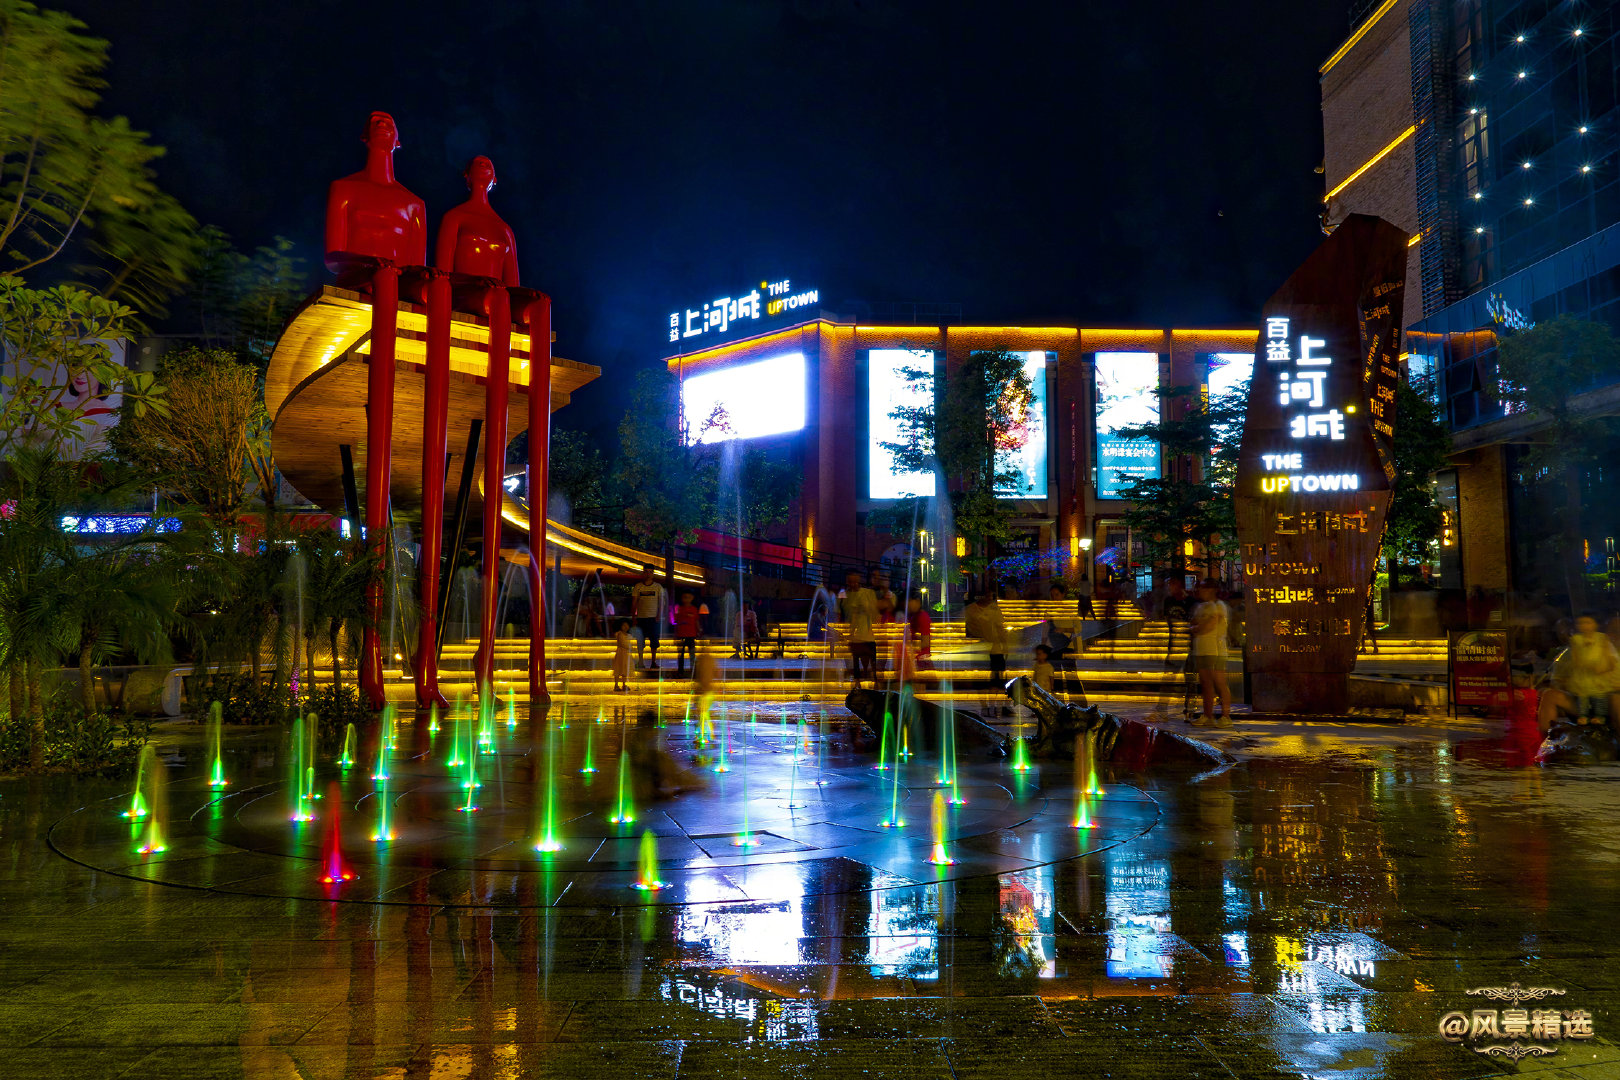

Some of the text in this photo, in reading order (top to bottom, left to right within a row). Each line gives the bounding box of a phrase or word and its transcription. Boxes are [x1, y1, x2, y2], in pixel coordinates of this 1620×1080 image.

[768, 280, 790, 297] THE
[683, 289, 761, 338] 上河城
[767, 290, 819, 315] UPTOWN
[1266, 316, 1291, 361] 百益
[1279, 335, 1346, 441] 上河城
[1370, 397, 1384, 418] THE
[1261, 453, 1303, 470] THE
[1261, 474, 1359, 494] UPTOWN
